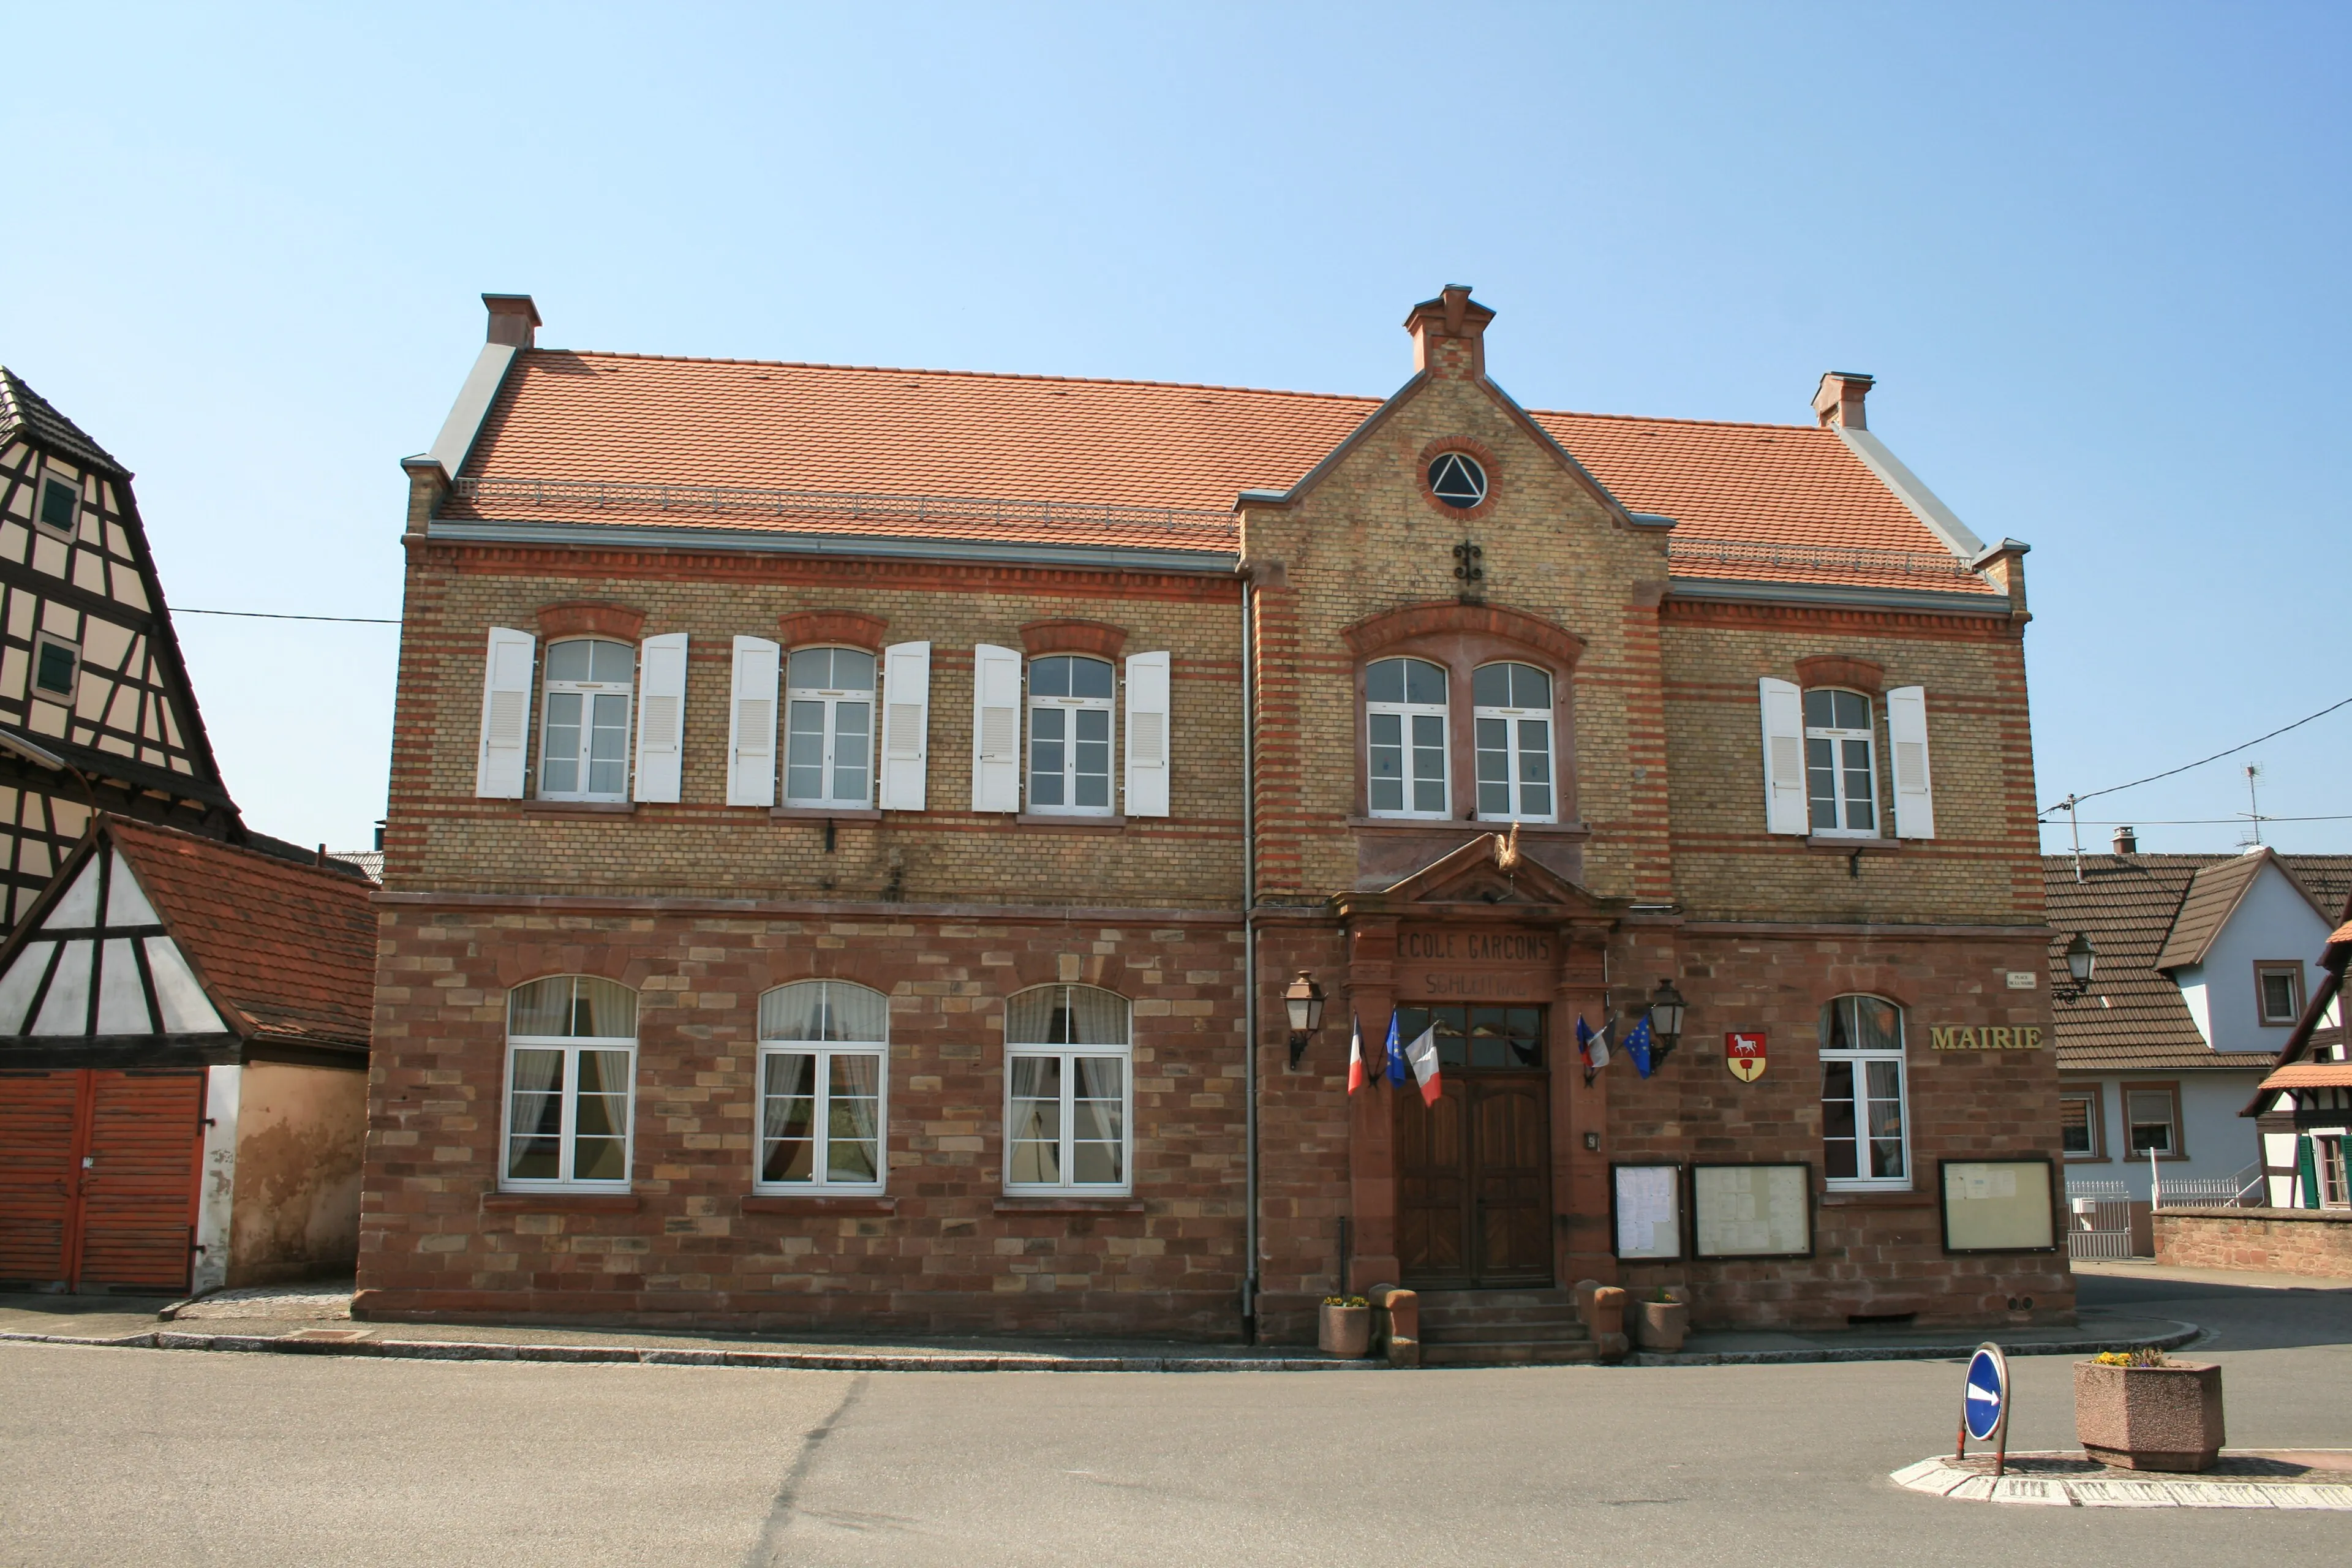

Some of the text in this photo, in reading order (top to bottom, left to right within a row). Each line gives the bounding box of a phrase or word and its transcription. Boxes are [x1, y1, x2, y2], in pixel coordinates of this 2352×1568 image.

[1397, 933, 1550, 960] ECOLE GARCONS
[1930, 1027, 2043, 1049] MAIRIE
